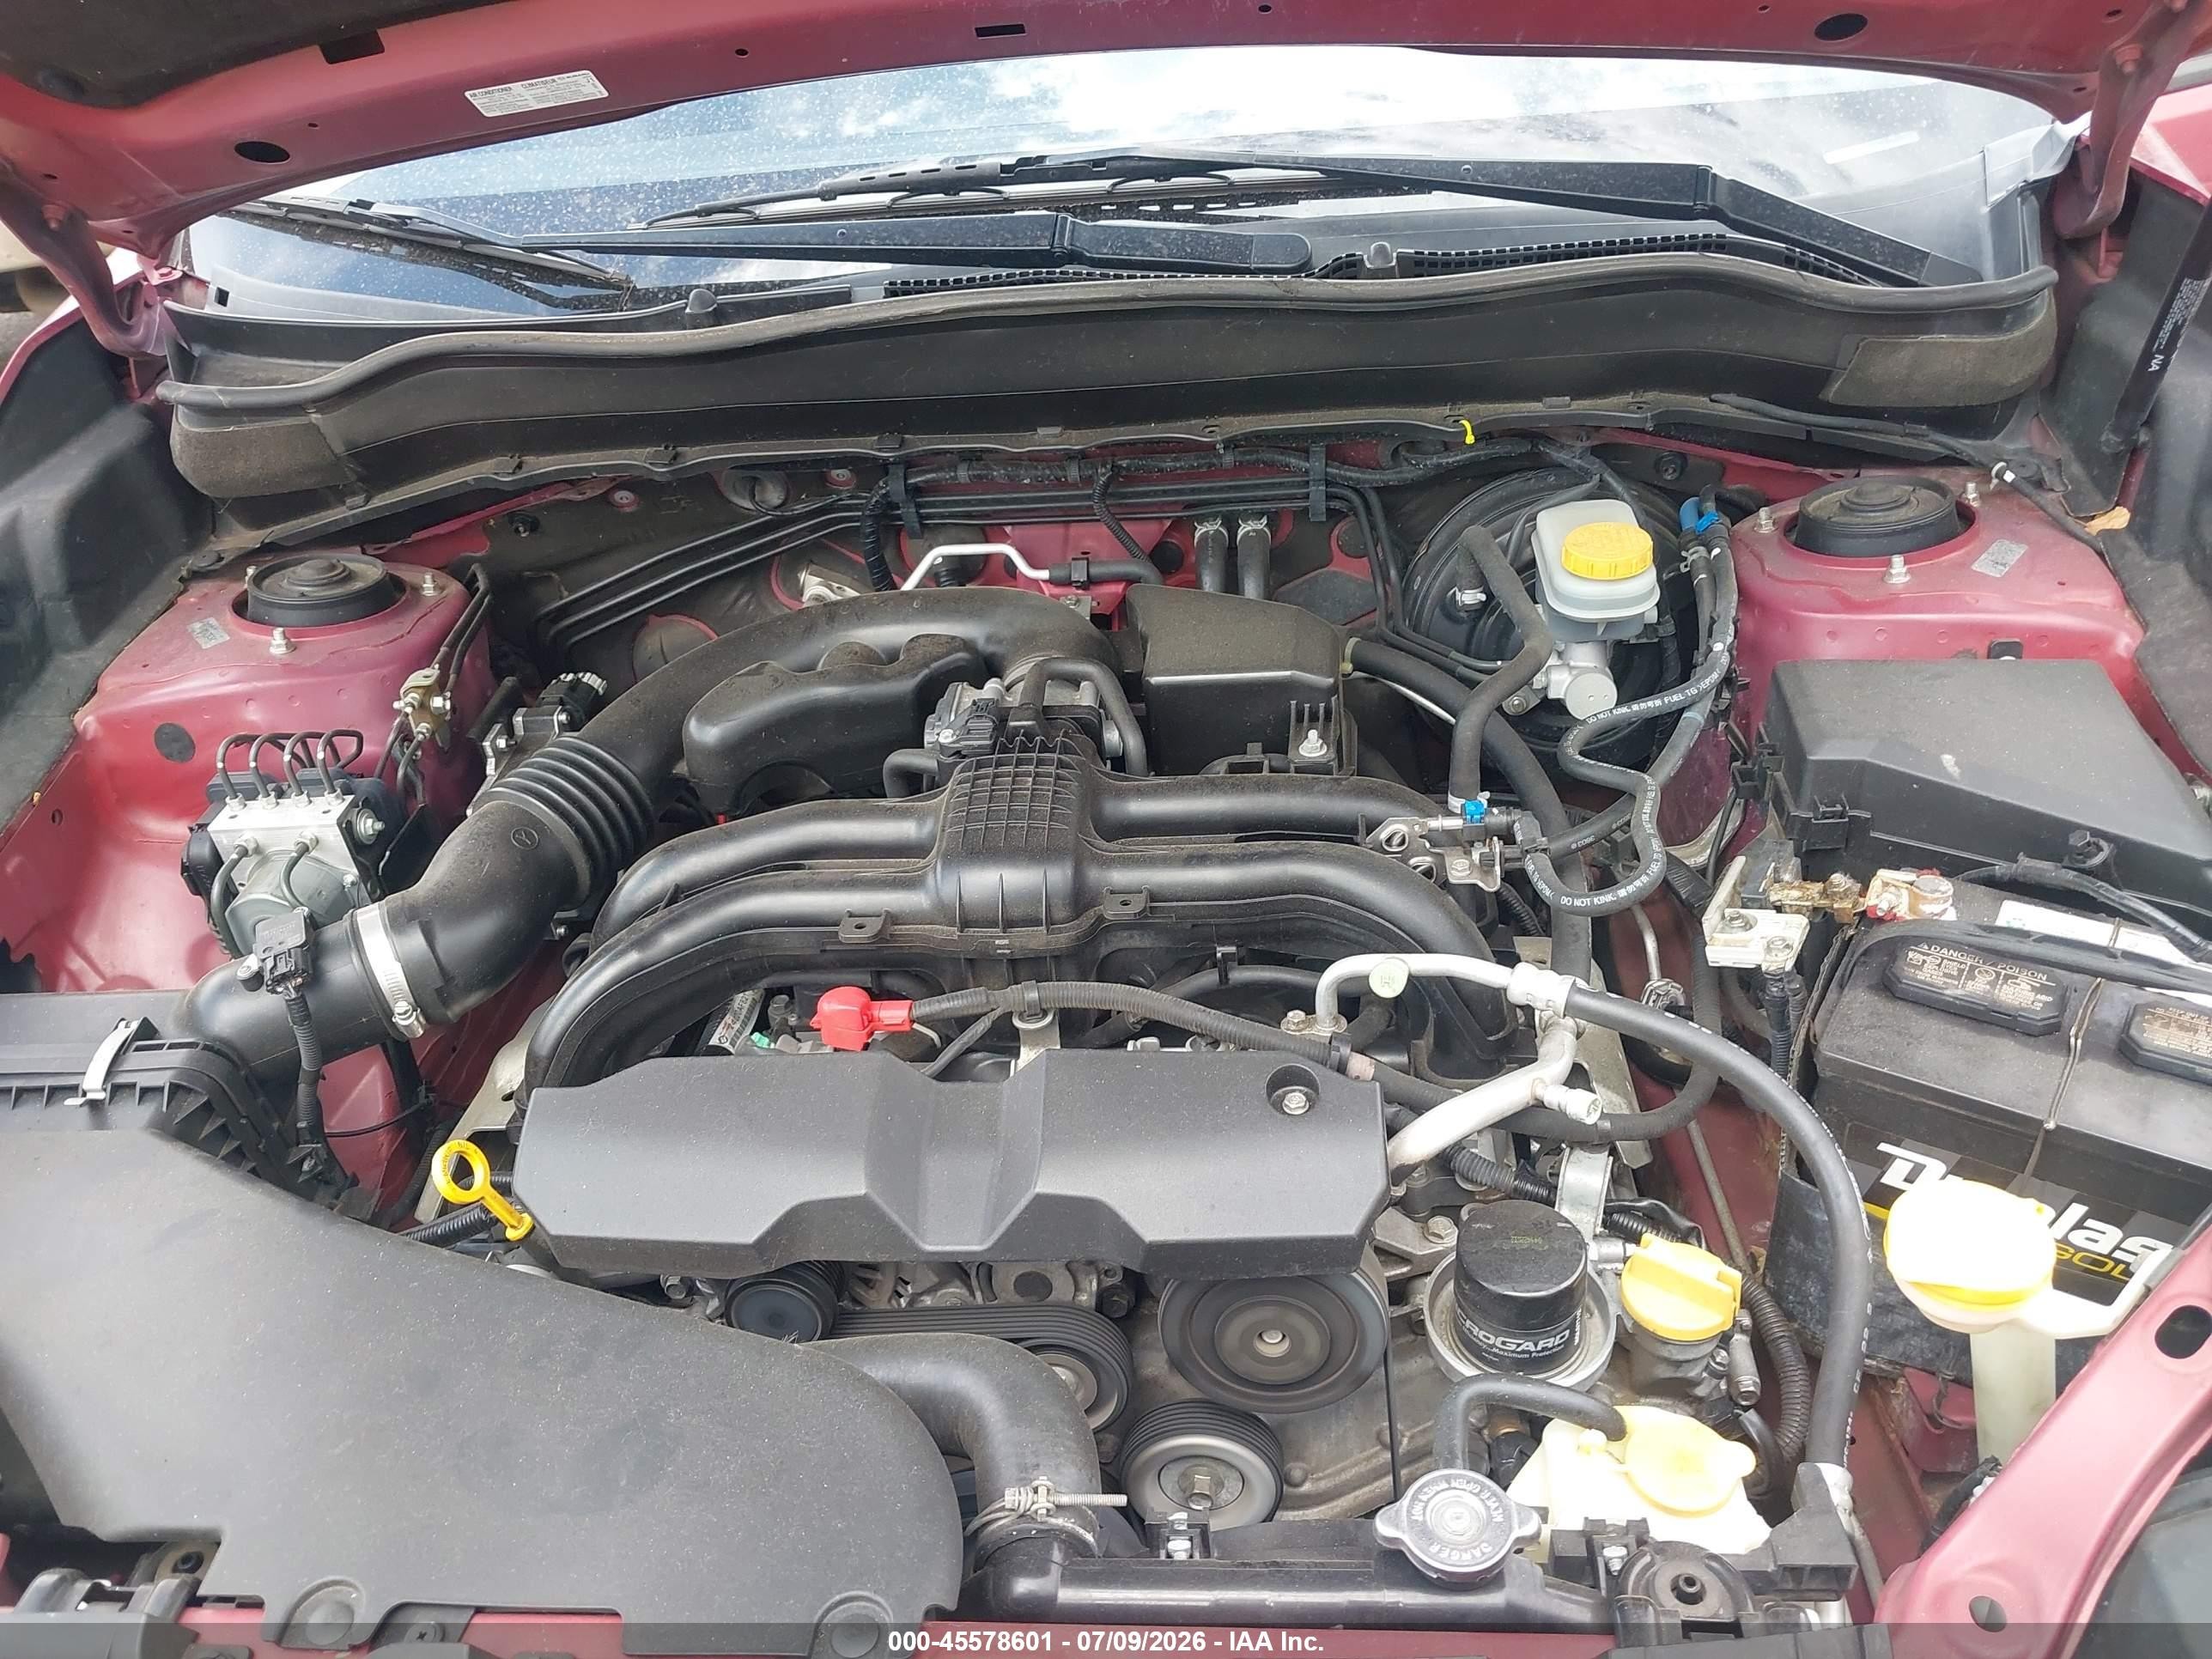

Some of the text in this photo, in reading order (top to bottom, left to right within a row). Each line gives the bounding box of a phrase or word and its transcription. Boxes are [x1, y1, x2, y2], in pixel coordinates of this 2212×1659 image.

[2148, 354, 2165, 372] NA
[1664, 695, 1686, 705] FUEL
[1560, 896, 1572, 906] DO
[1573, 896, 1592, 907] NOT
[1931, 945, 1984, 964] DANGER
[1996, 961, 2048, 981] POISON
[1428, 1541, 1493, 1561] DANGER
